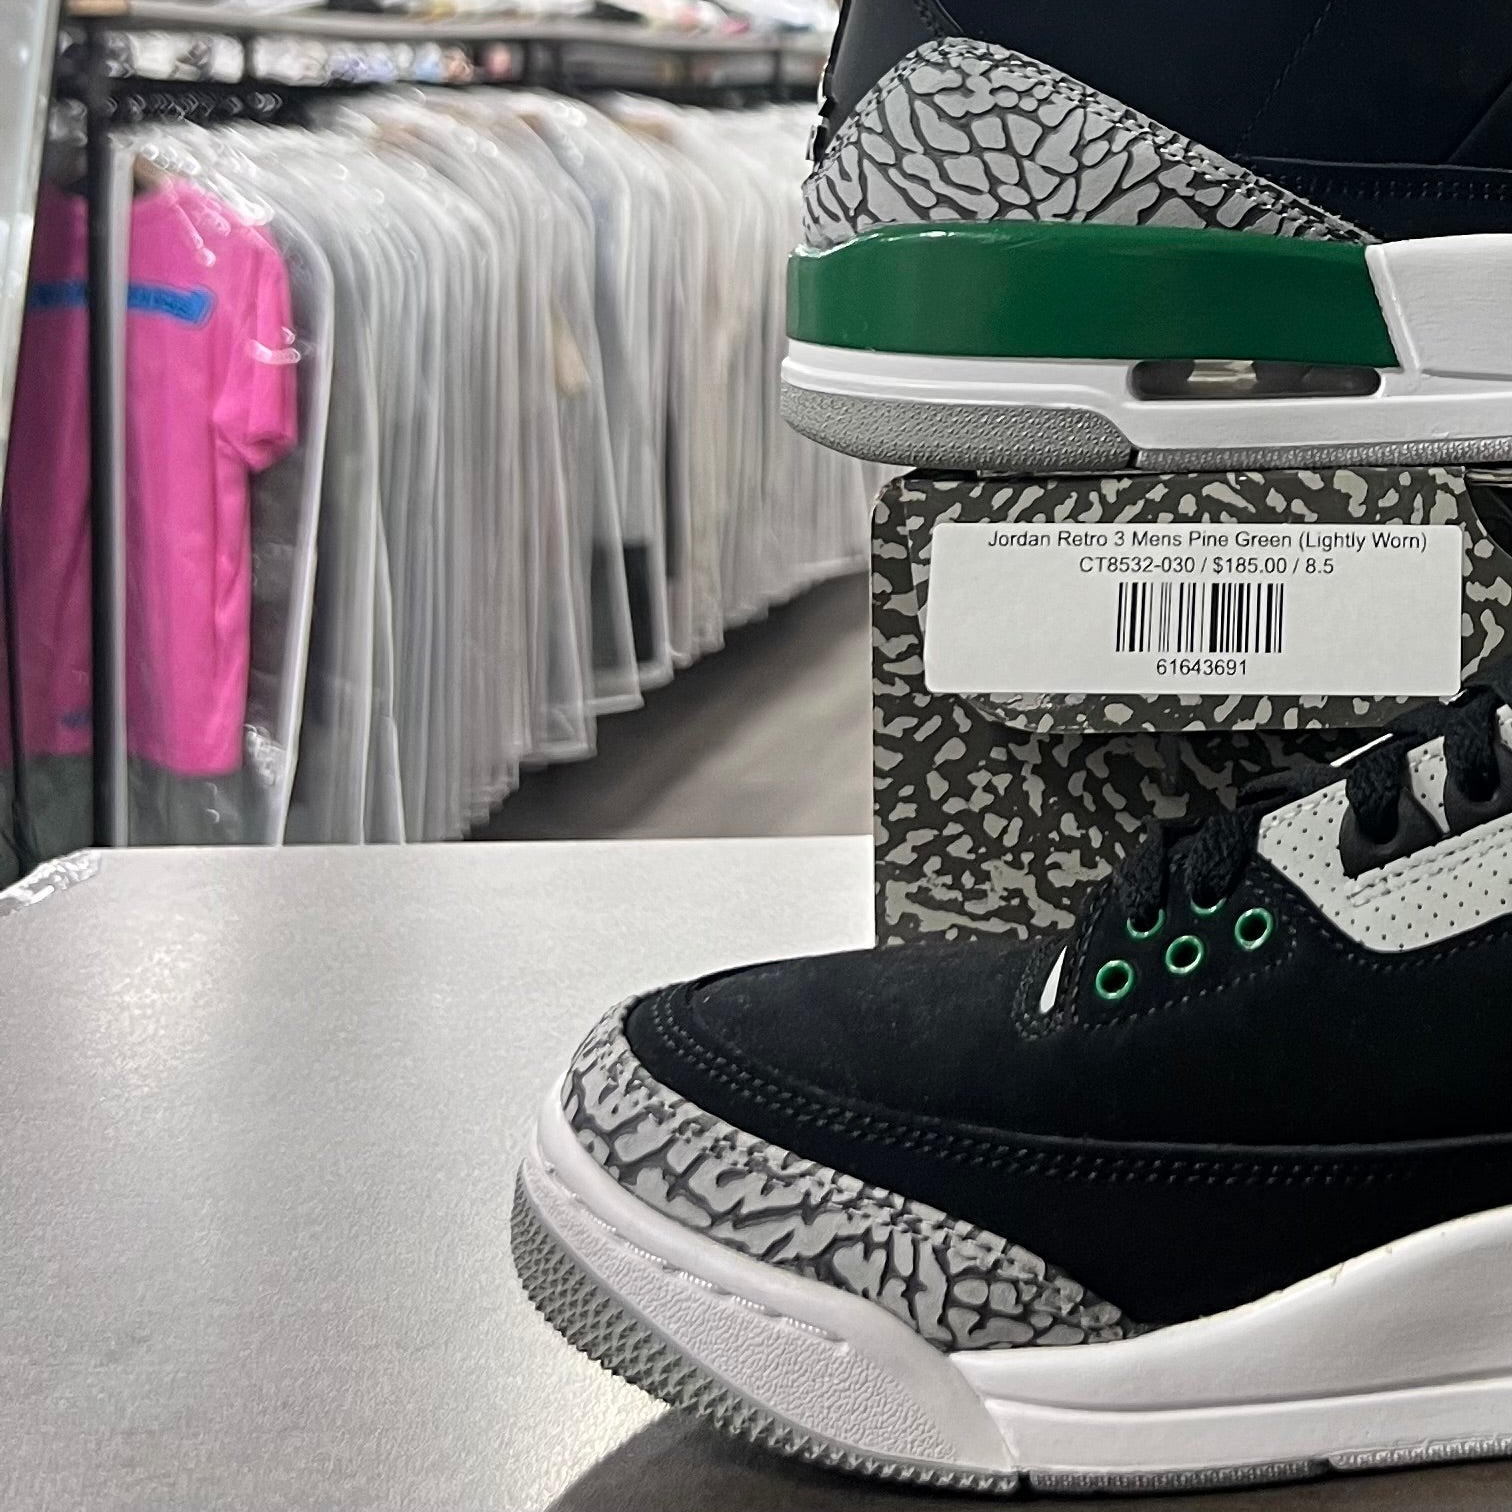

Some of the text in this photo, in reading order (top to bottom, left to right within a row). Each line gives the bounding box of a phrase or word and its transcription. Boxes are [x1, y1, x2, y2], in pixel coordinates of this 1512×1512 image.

[988, 530, 1427, 553] Jordan Retro 3 Mens Pine Green (Lightly Worn)
[1079, 556, 1334, 575] CT8532-030 / $185.00 / 8.5
[1156, 658, 1246, 676] 61643691
